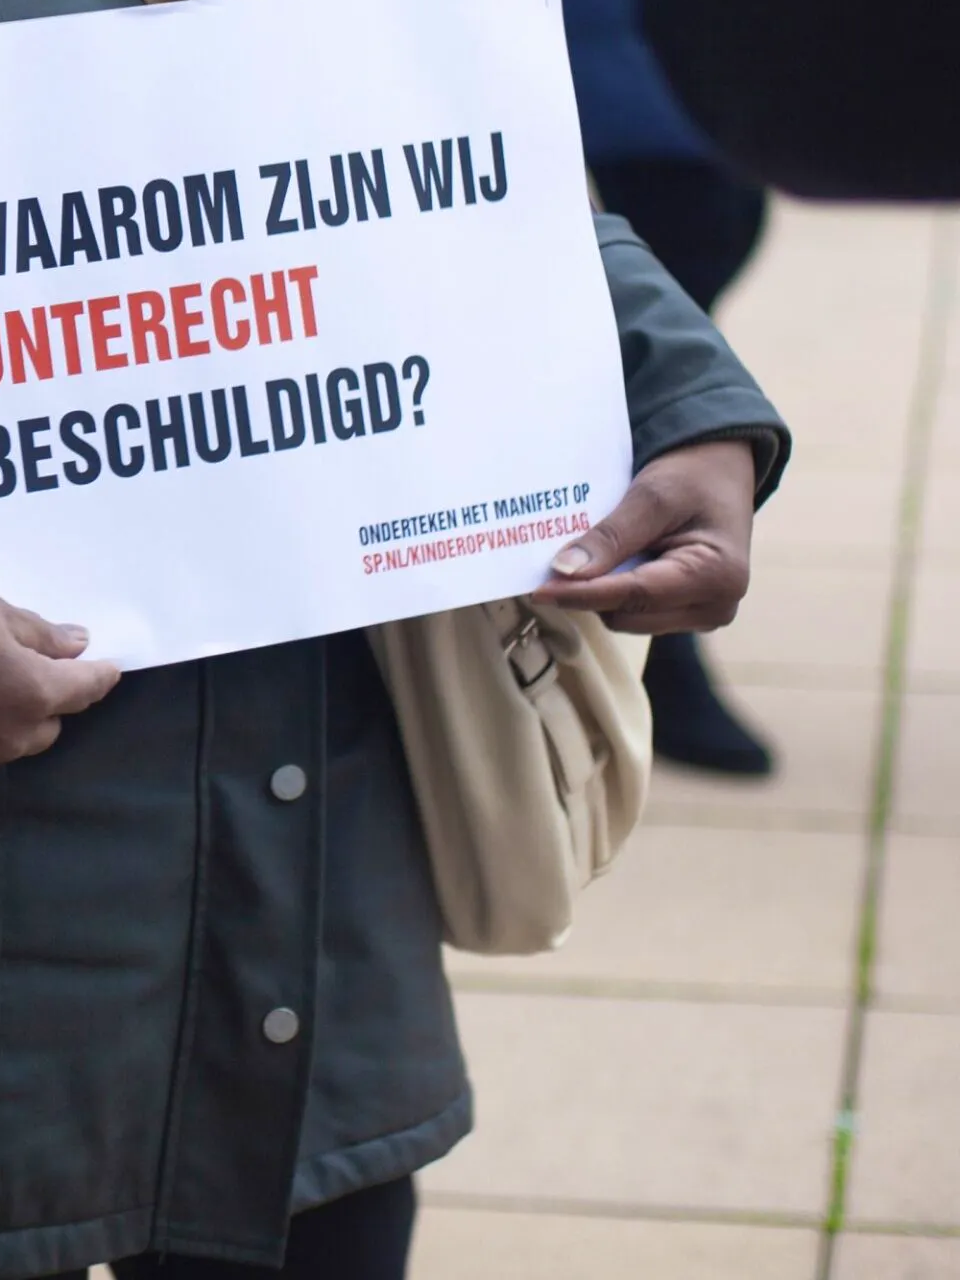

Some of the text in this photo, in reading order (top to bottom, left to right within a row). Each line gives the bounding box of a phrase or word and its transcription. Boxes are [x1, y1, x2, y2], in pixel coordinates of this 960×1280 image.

[259, 149, 391, 235] ZIJN
[403, 132, 507, 212] WIJ
[359, 483, 590, 546] ONDERTEKEN HET MANIFEST OP
[363, 512, 590, 574] SP.NL/KINDEROPVANGTOESLAG
